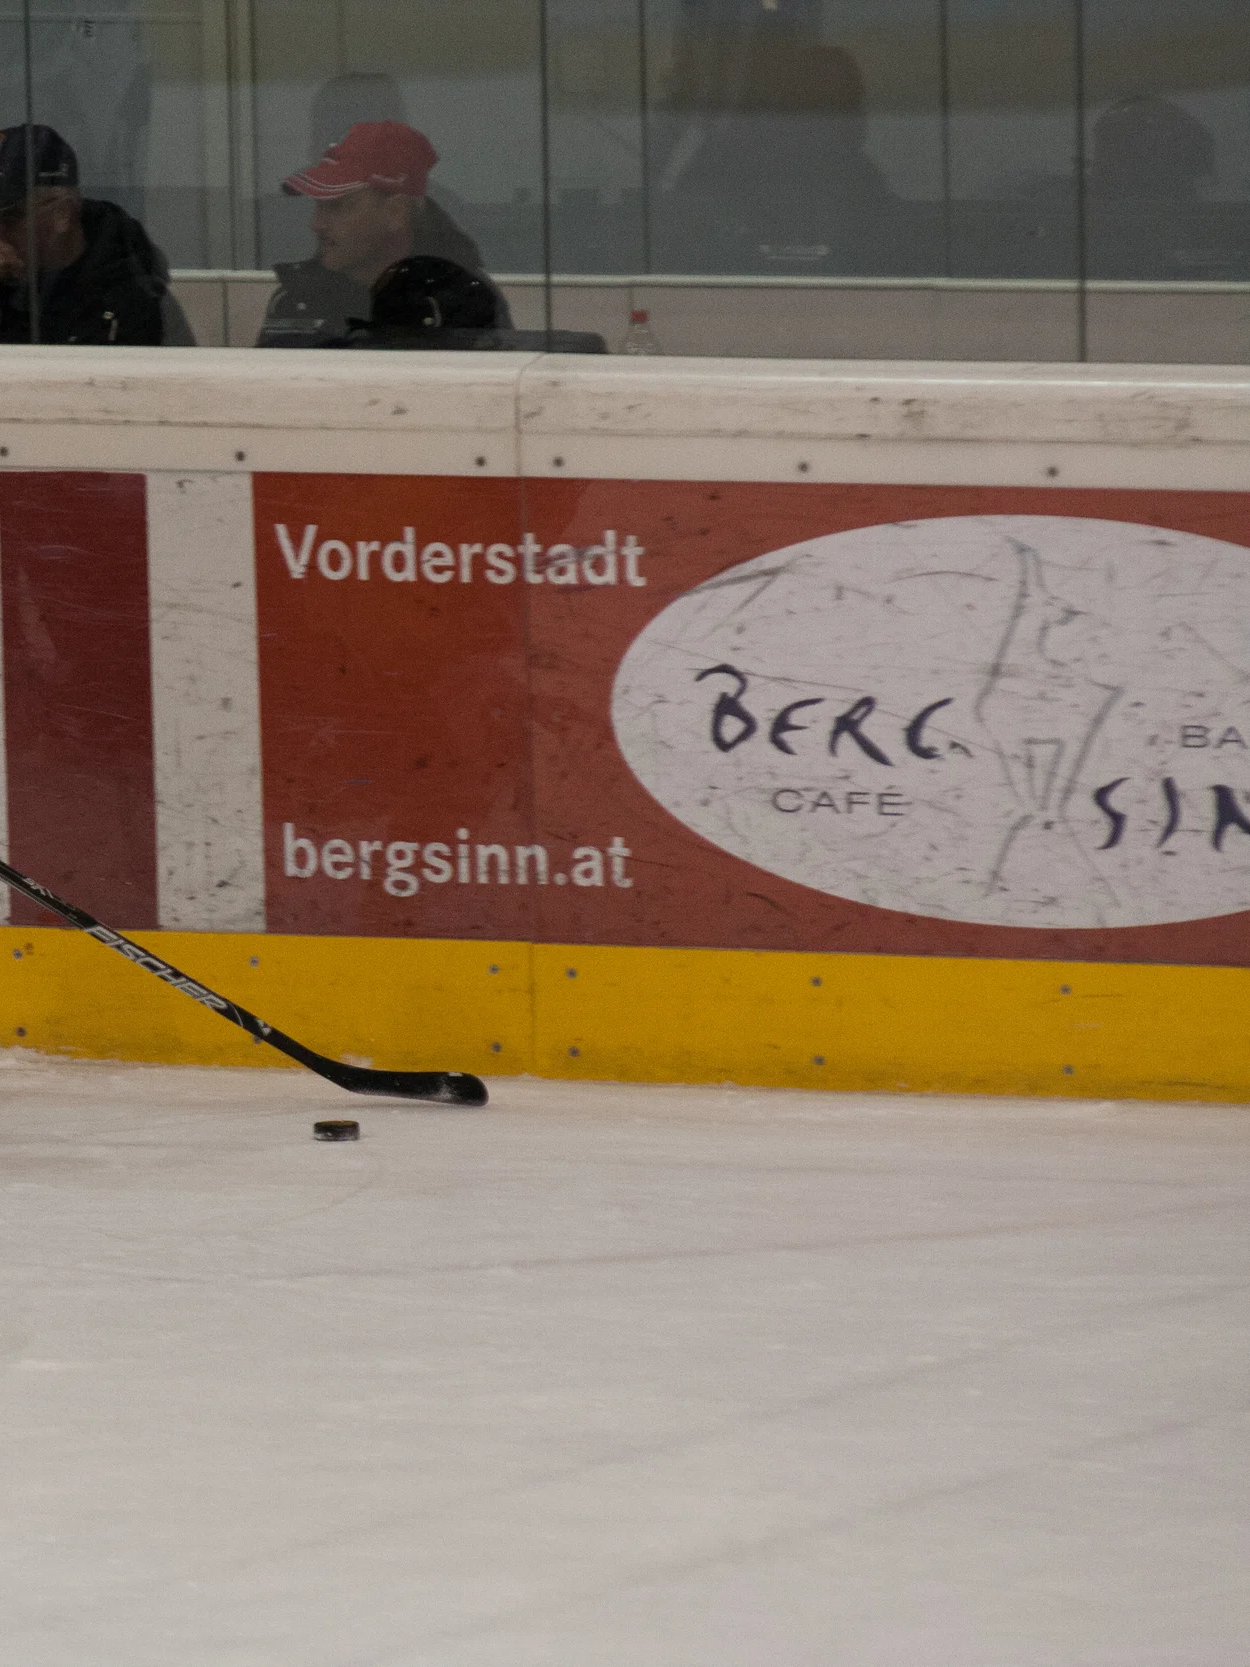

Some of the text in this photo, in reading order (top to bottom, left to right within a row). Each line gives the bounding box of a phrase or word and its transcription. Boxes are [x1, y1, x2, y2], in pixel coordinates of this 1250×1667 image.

[274, 523, 648, 588] Vorderstadt
[770, 785, 908, 817] CAFÉ
[282, 821, 634, 898] bergsinn.at
[85, 925, 228, 1010] FISCHER
